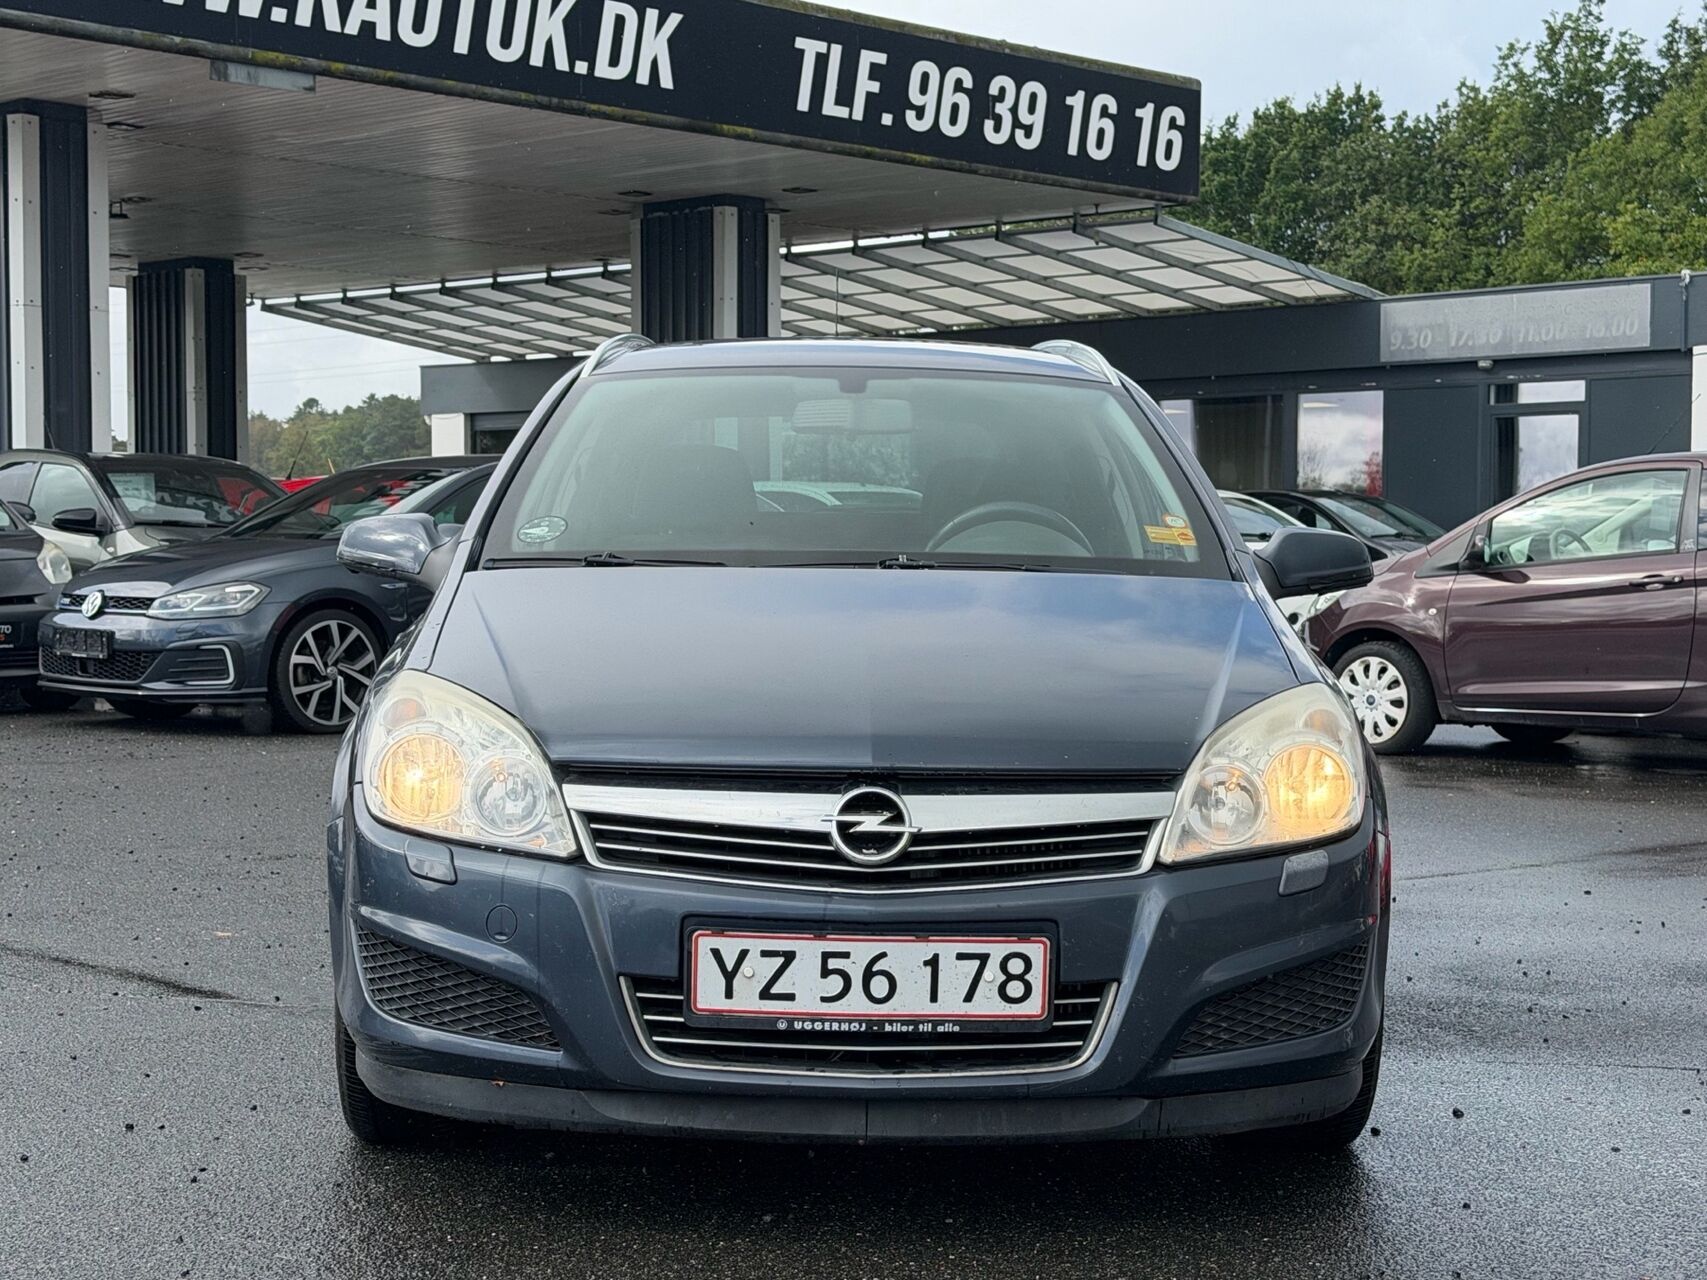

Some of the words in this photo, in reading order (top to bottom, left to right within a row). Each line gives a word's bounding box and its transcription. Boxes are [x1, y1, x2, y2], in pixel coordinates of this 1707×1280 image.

[794, 36, 893, 126] TLF.
[905, 60, 974, 138] 96
[983, 75, 1047, 150] 39
[1065, 89, 1118, 161] 16
[1135, 101, 1186, 171] 16
[1389, 327, 1432, 350] 9.30
[709, 947, 797, 1002] YZ
[819, 951, 898, 1005] 56
[922, 951, 1034, 1005] 178
[793, 1021, 866, 1032] UGGERHØJ
[885, 1022, 914, 1032] biler
[918, 1022, 932, 1032] til
